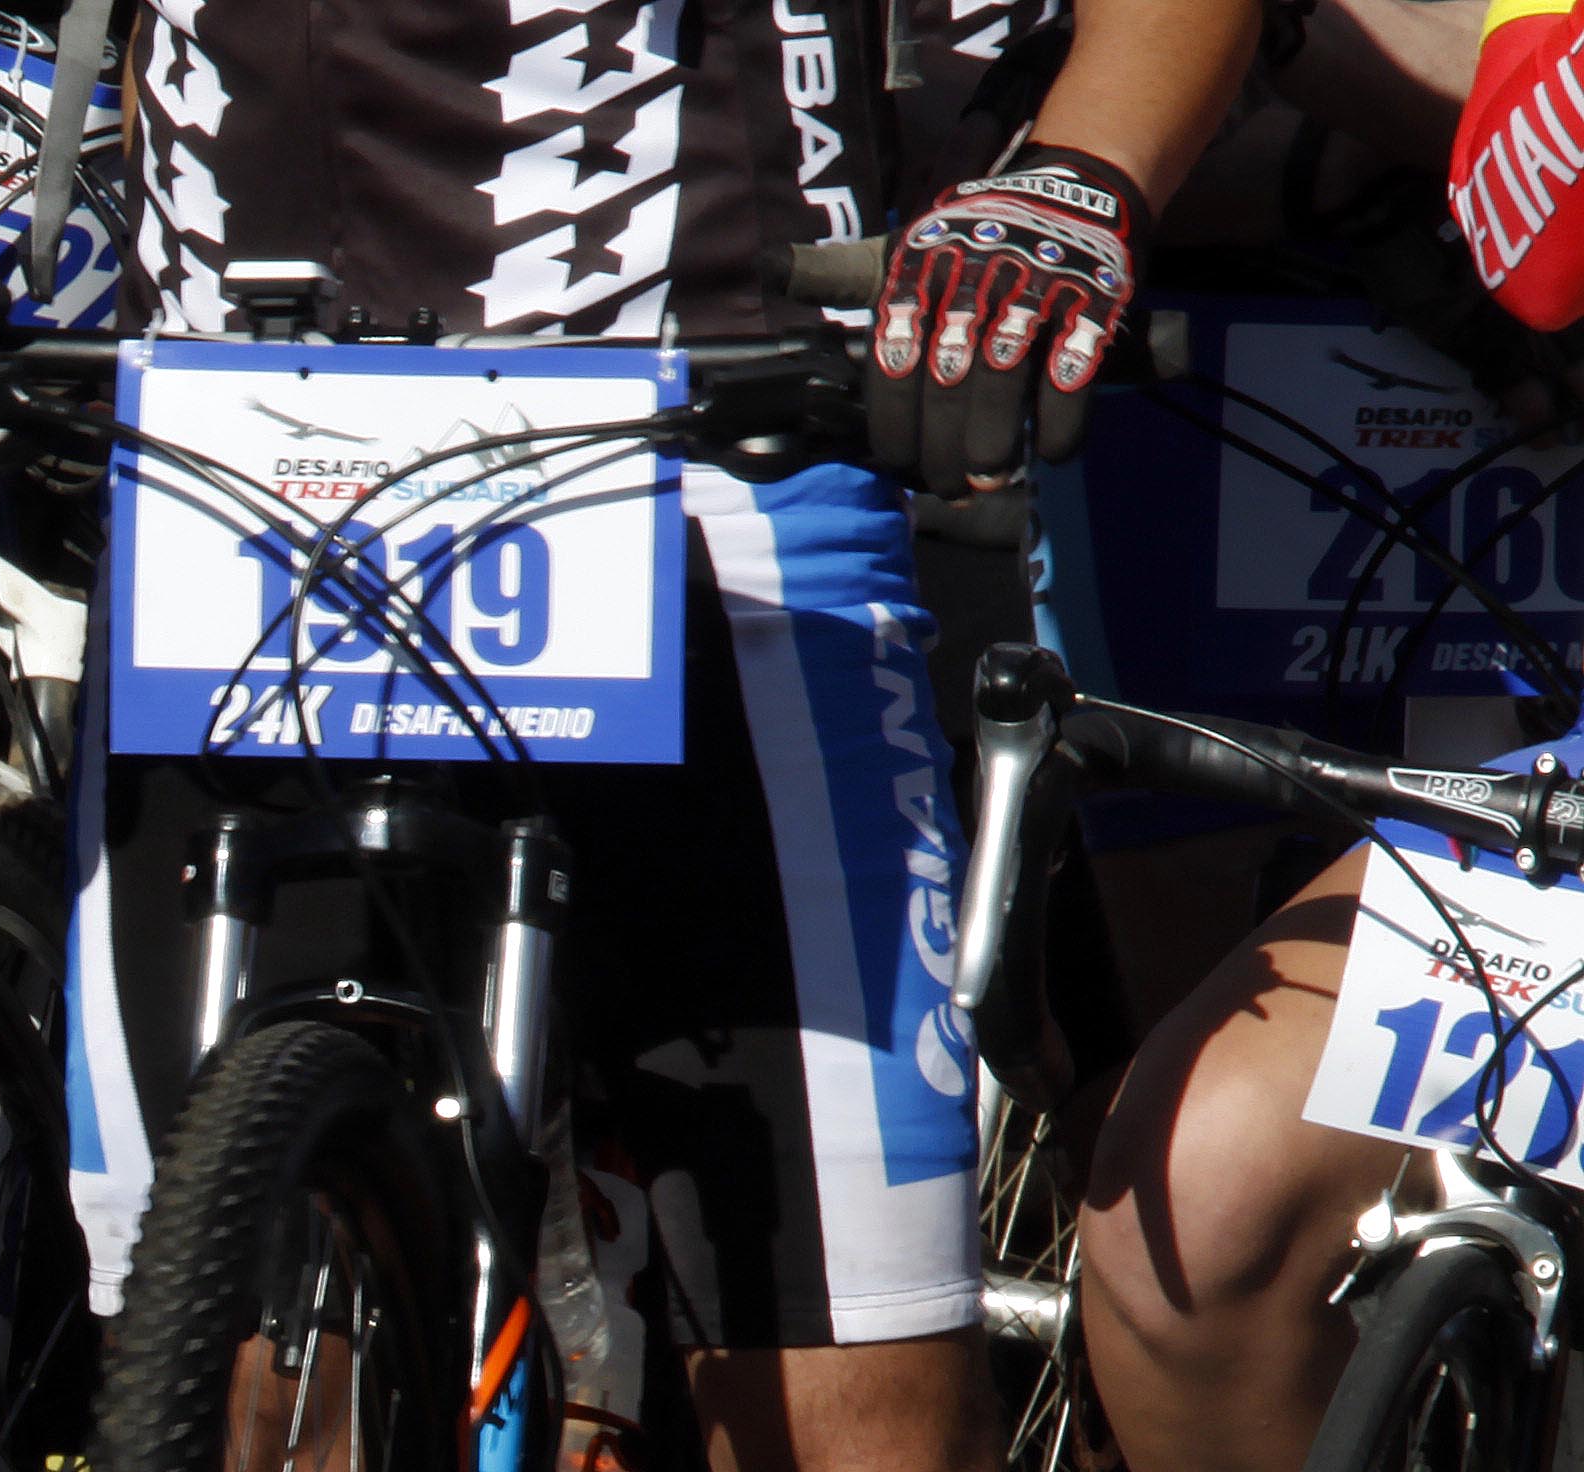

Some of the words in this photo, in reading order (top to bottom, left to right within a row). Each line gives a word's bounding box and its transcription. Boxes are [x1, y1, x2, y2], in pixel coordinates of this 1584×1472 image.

[772, 0, 874, 328] UBAR
[1355, 406, 1473, 428] DESAFIO
[1355, 428, 1464, 449] TREK
[237, 518, 551, 667] 1919
[208, 685, 334, 745] 24K
[1369, 997, 1584, 1172] 121
